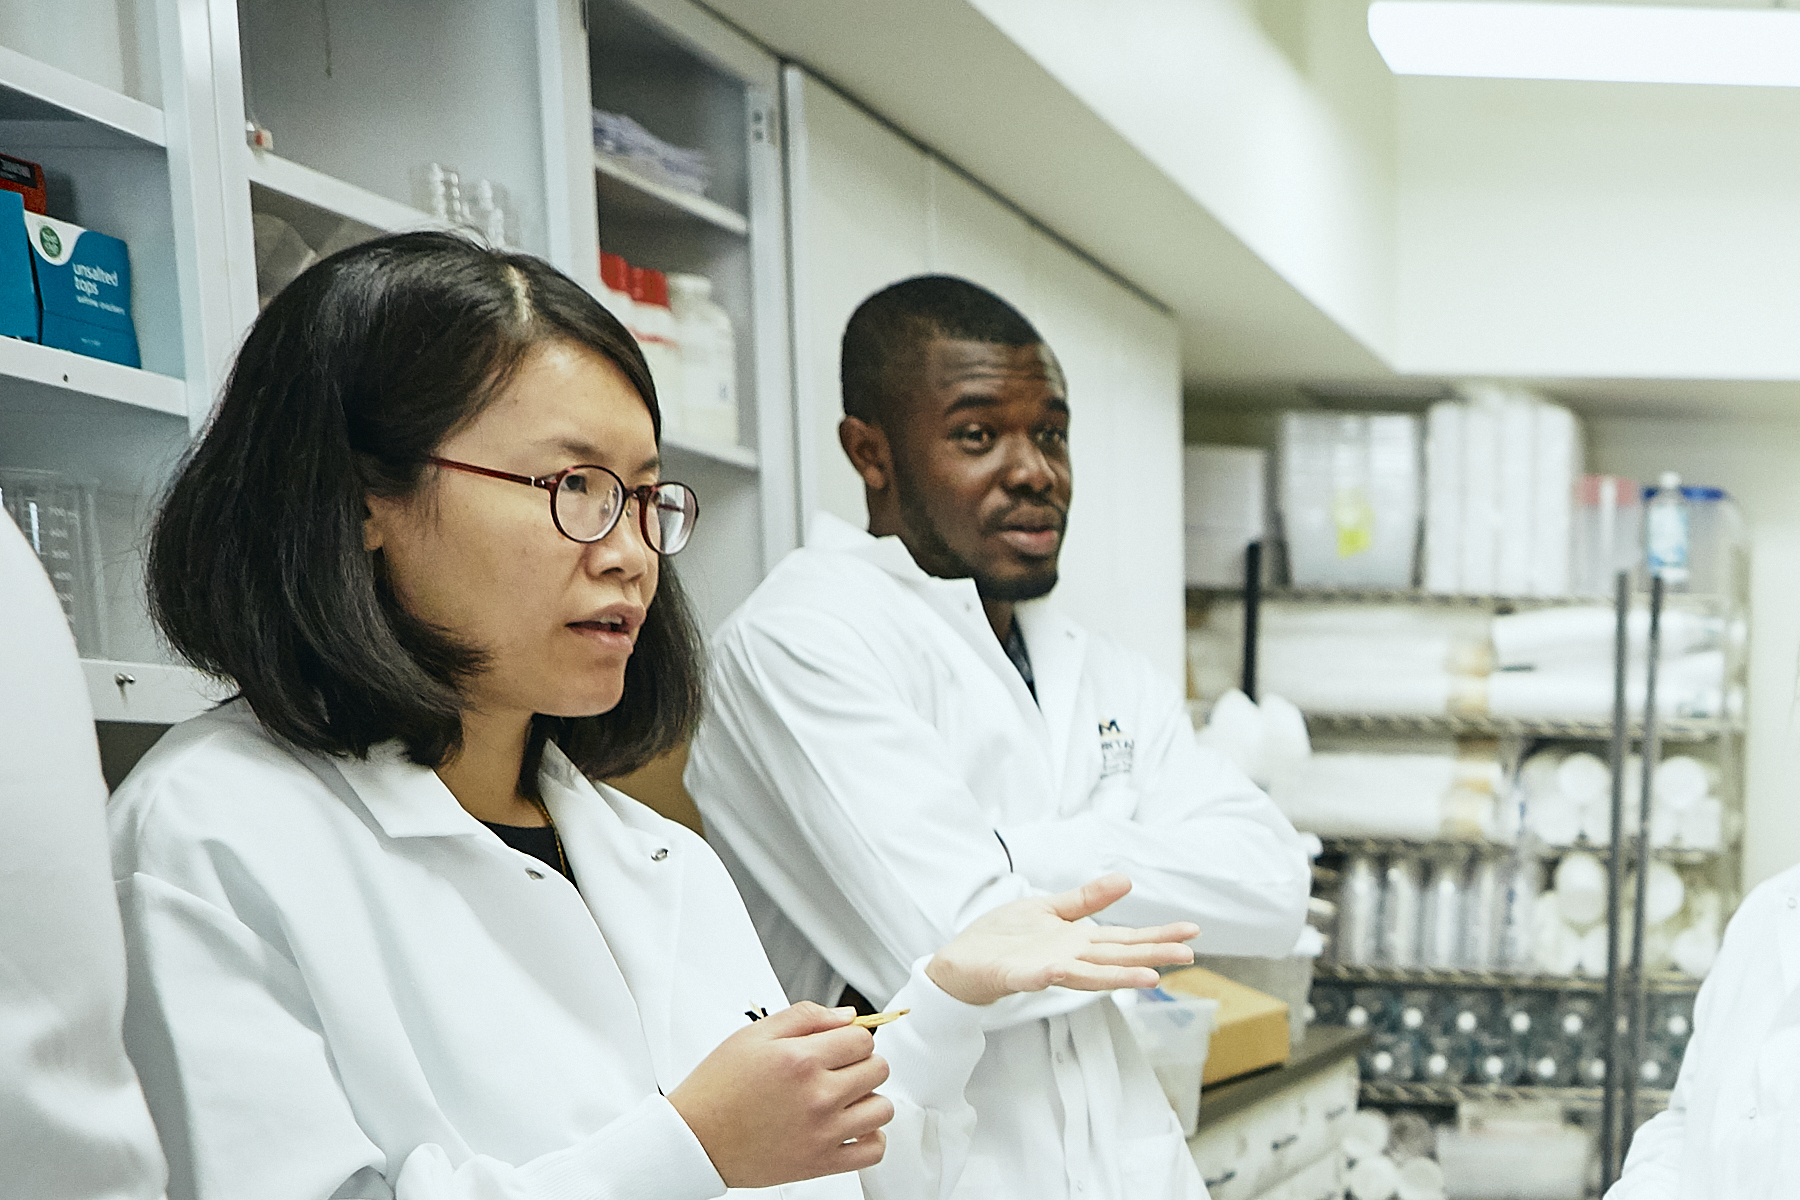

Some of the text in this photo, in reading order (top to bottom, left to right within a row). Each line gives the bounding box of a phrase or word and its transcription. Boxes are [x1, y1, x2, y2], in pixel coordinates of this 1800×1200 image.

[72, 262, 119, 287] unsalted
[74, 275, 99, 297] tops
[1098, 718, 1121, 737] M
